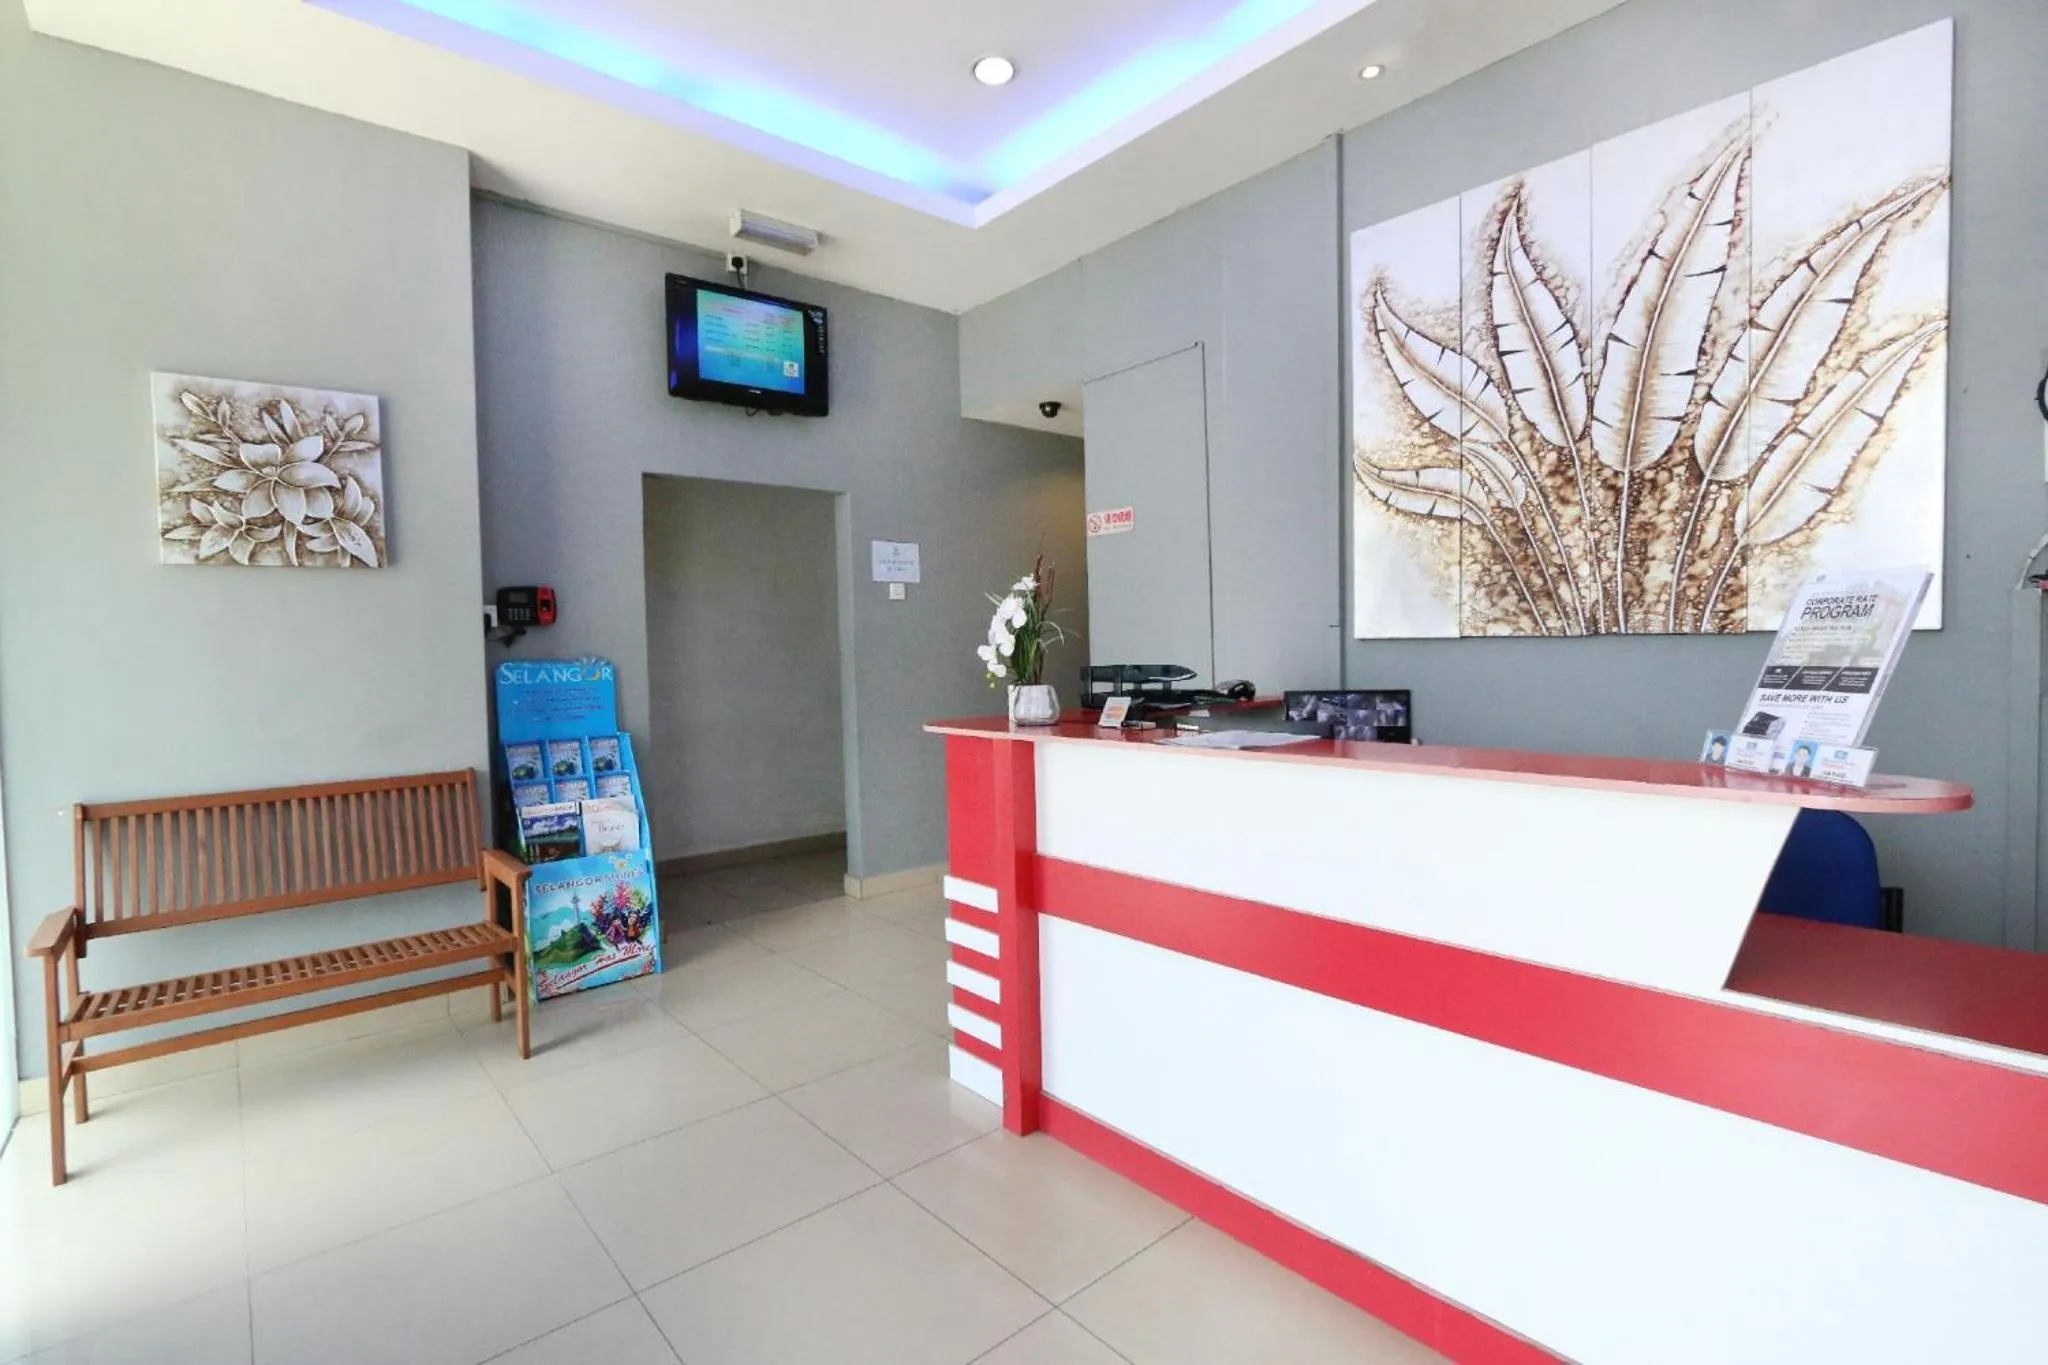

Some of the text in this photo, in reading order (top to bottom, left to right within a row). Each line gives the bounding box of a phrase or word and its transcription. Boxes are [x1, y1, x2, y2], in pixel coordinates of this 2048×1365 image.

[1800, 604, 1876, 619] PROGRAM
[500, 661, 613, 685] SELANGOR
[1760, 693, 1849, 704] SAVE MORE WITH US
[535, 877, 601, 894] SELANGOR
